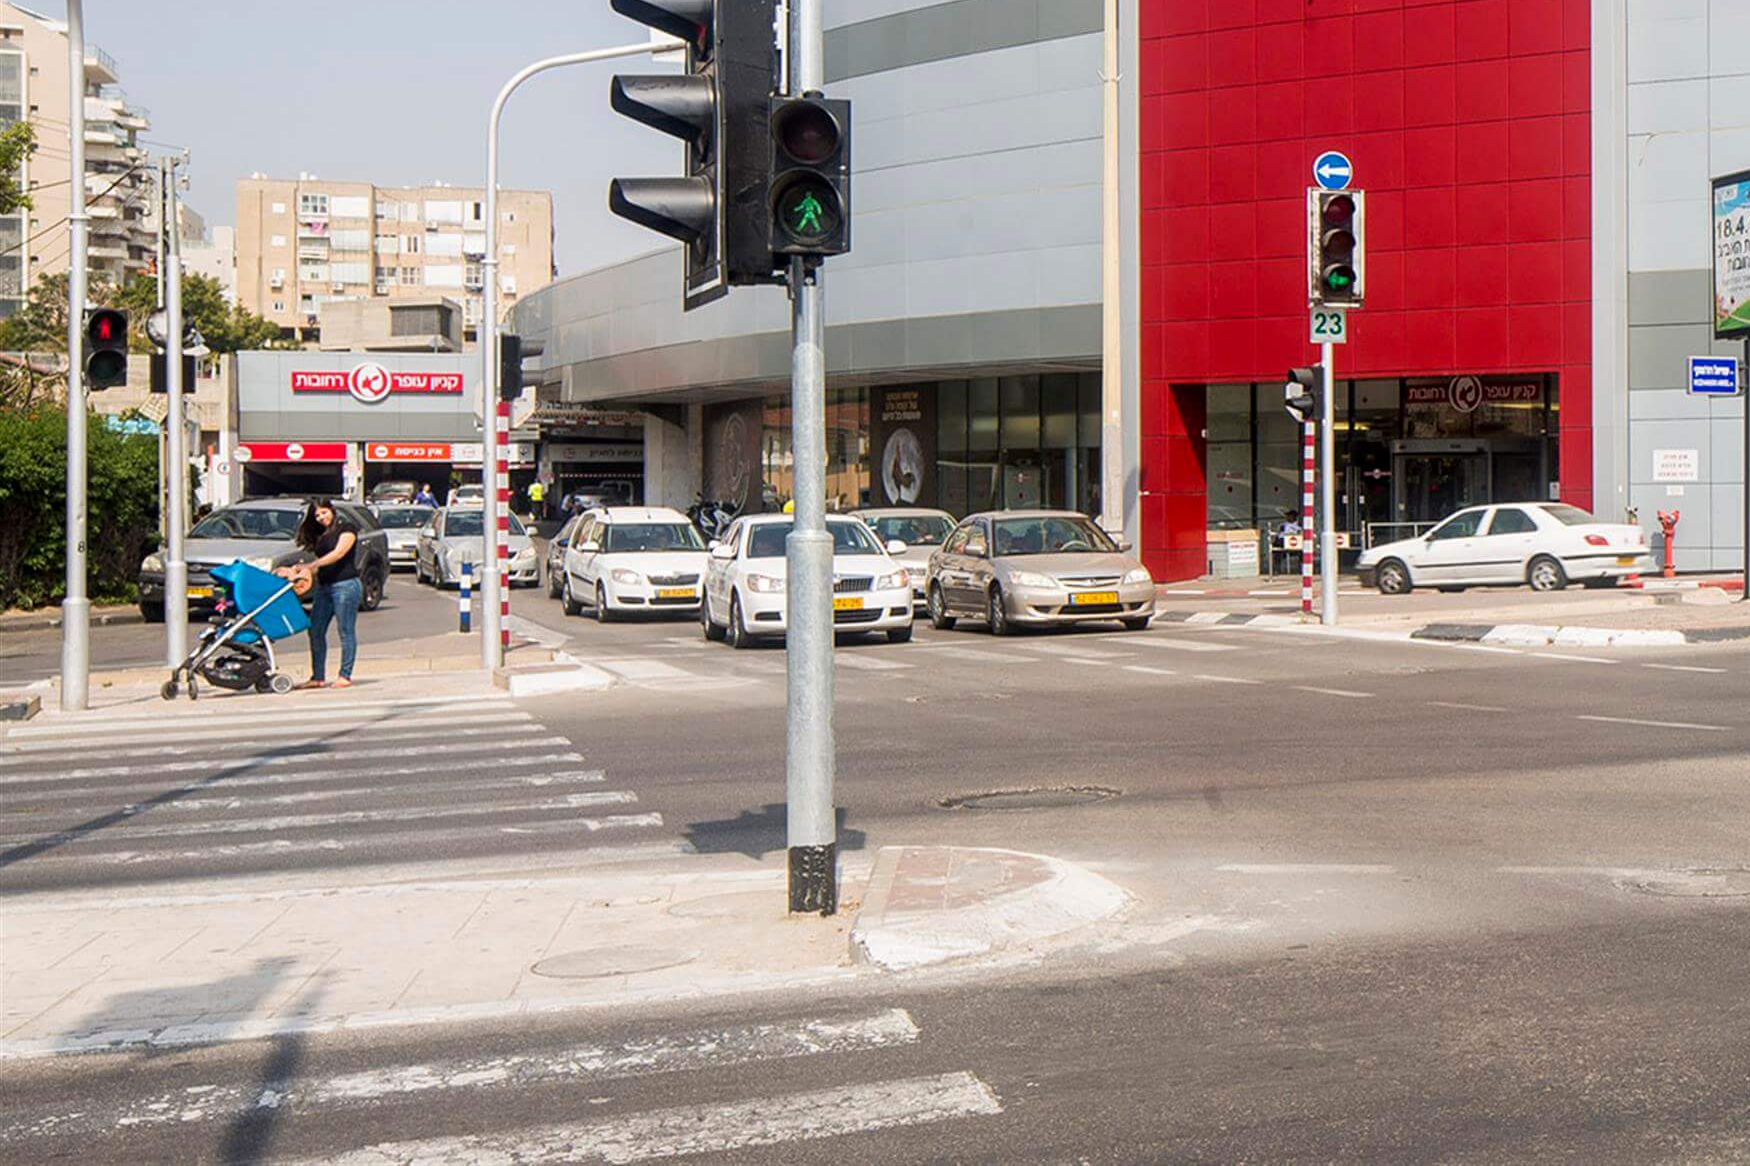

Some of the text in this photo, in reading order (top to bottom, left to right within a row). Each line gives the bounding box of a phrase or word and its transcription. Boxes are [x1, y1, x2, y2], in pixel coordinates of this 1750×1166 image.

[1314, 312, 1343, 335] 23
[294, 374, 459, 391] קניון עופר רחובות
